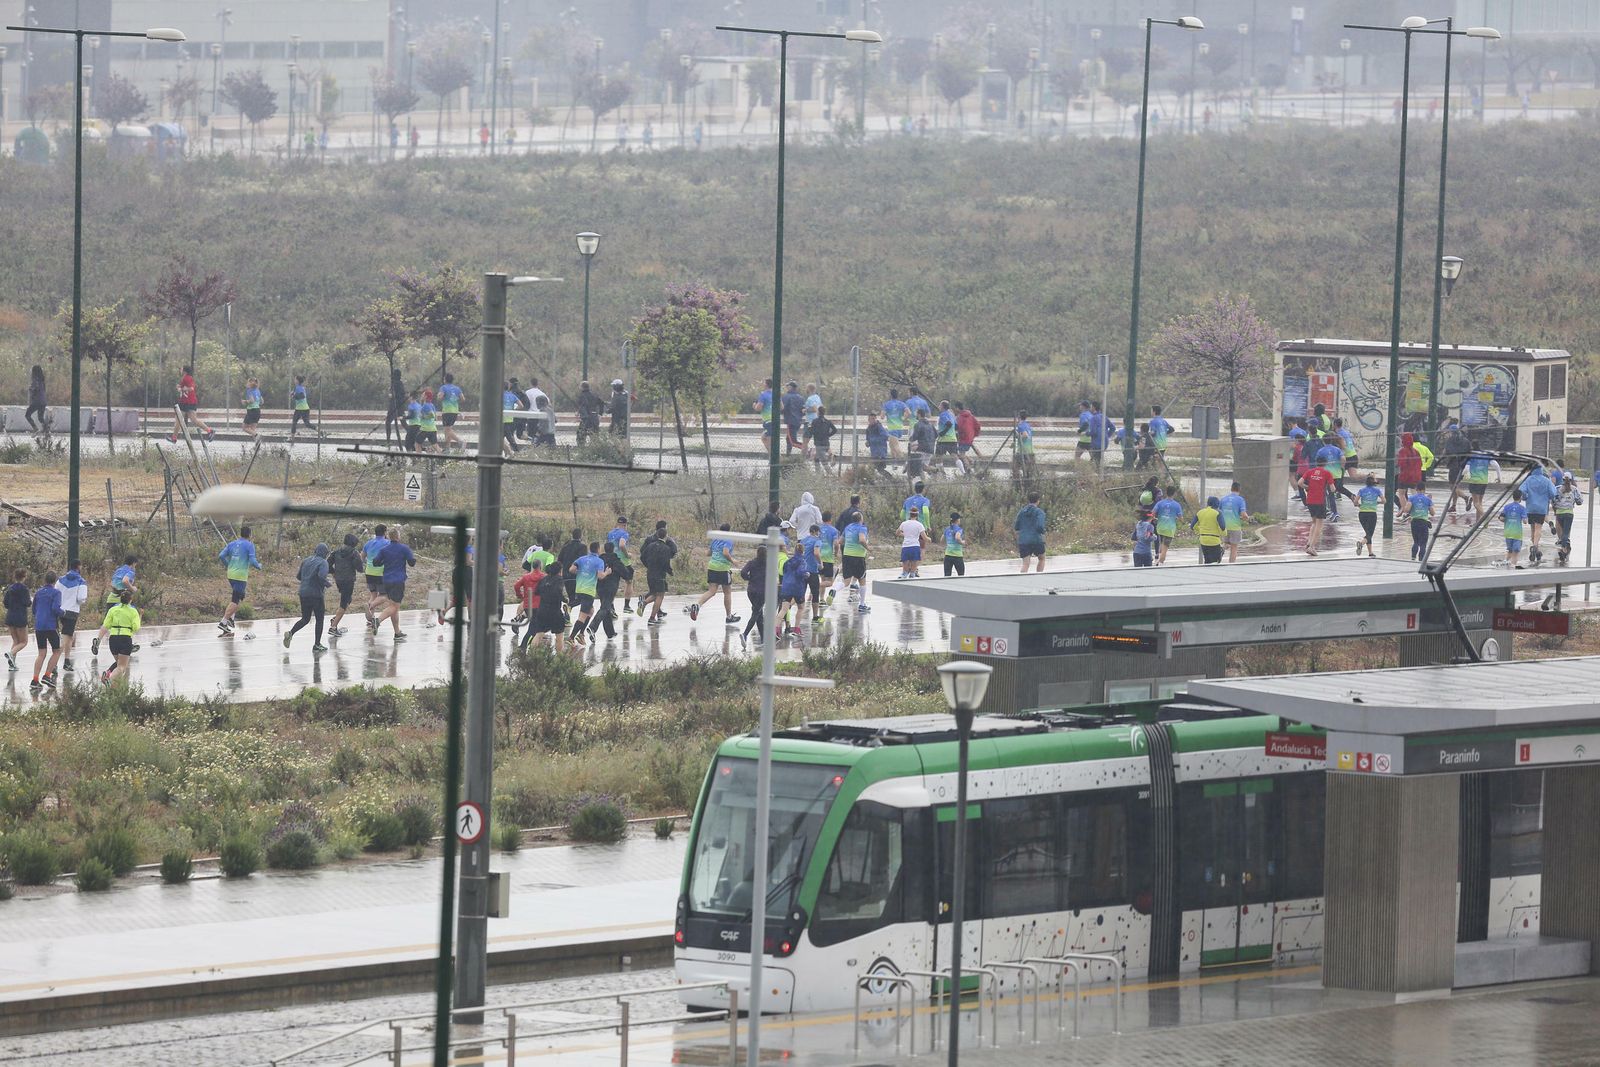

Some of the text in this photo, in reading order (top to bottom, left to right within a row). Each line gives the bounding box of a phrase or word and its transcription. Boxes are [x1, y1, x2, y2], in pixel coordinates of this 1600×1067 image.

[1260, 622, 1288, 634] Andén 1
[1497, 618, 1535, 630] El Perchel
[1052, 632, 1090, 649] Paraninfo
[1440, 747, 1480, 765] Paraninfo
[720, 930, 740, 941] CAF
[717, 952, 736, 961] 3090
